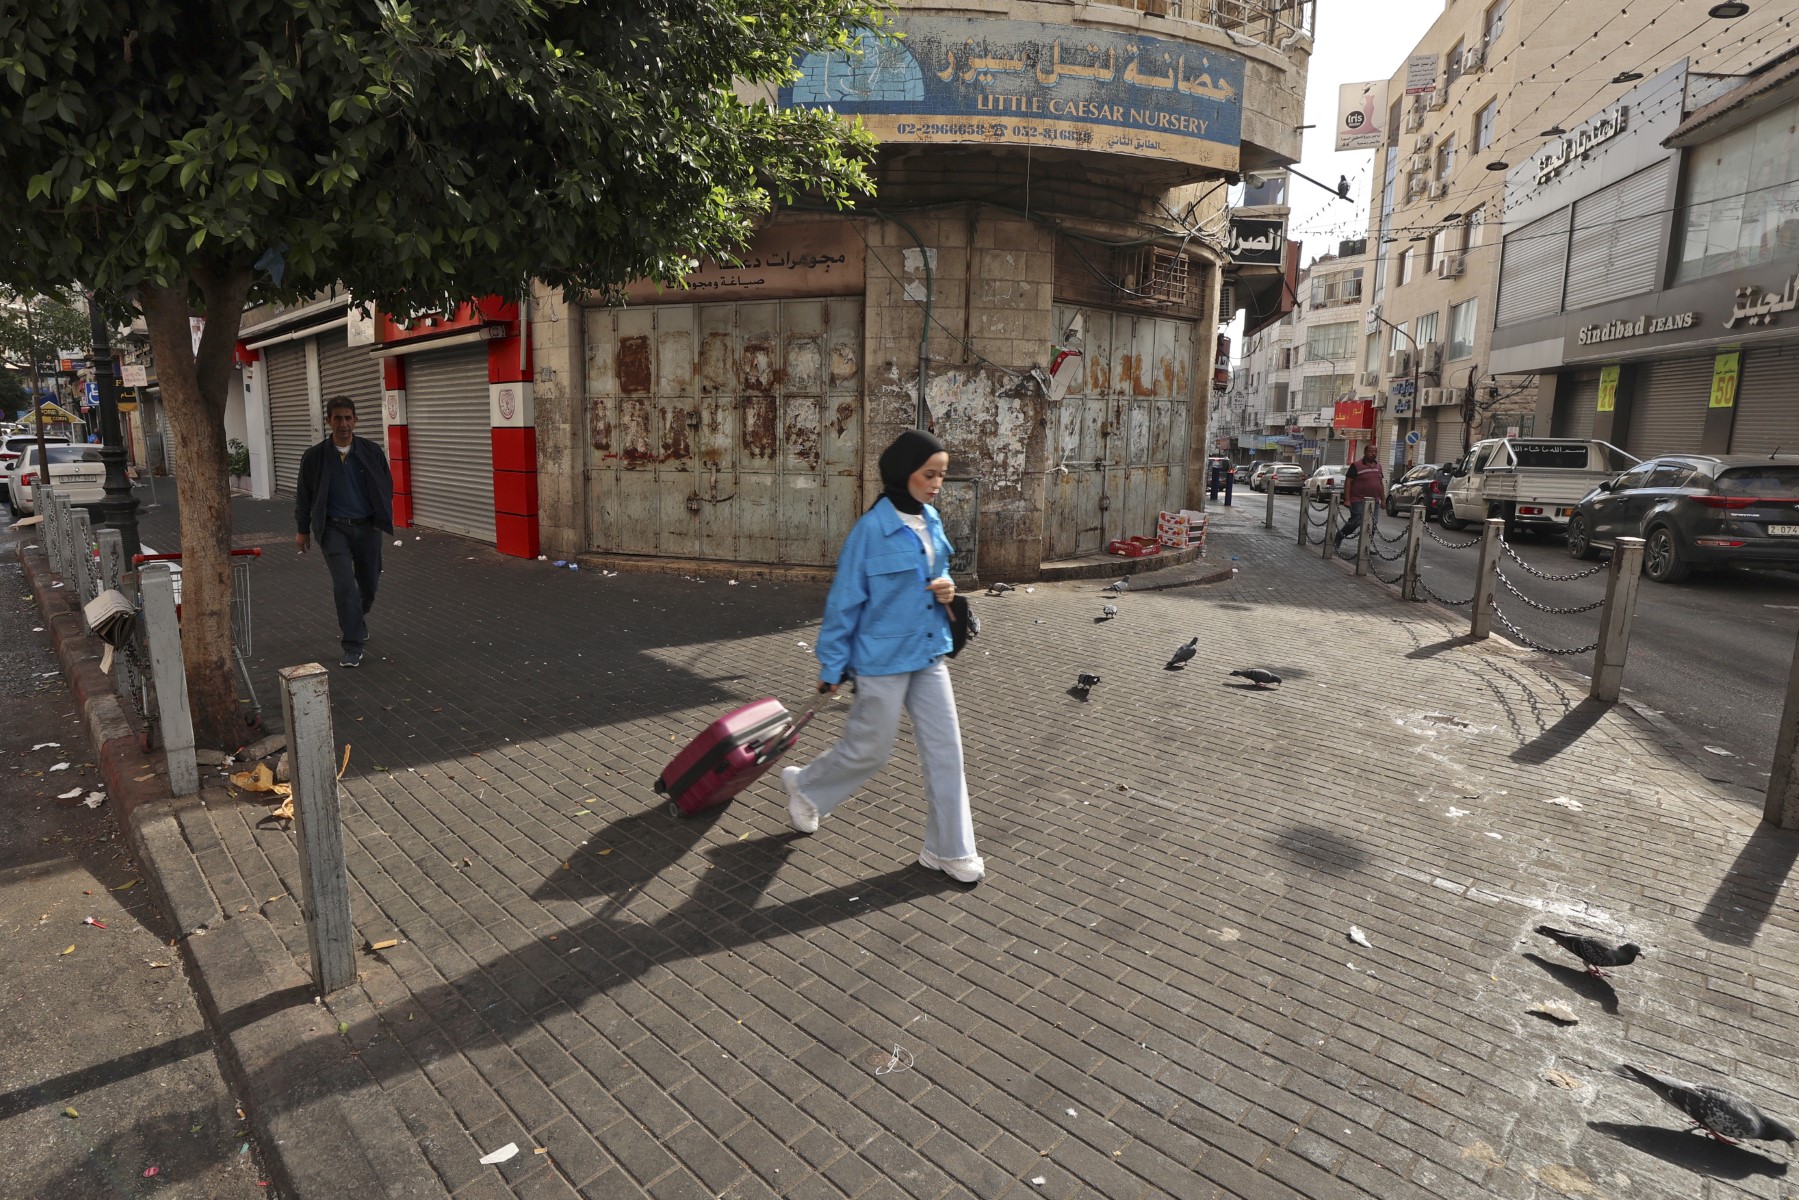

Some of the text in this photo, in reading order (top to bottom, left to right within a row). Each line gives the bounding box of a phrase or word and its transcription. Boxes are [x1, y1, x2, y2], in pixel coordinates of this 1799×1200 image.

[934, 35, 1235, 102] حضانة لتل سيزر
[977, 93, 1209, 136] LITTLE CAESAR NURSERY
[1348, 113, 1363, 123] Iris
[766, 250, 846, 273] مجوهرات
[720, 276, 766, 289] صياغة
[1578, 312, 1694, 346] Sindibad JEANS
[1714, 375, 1736, 406] 50
